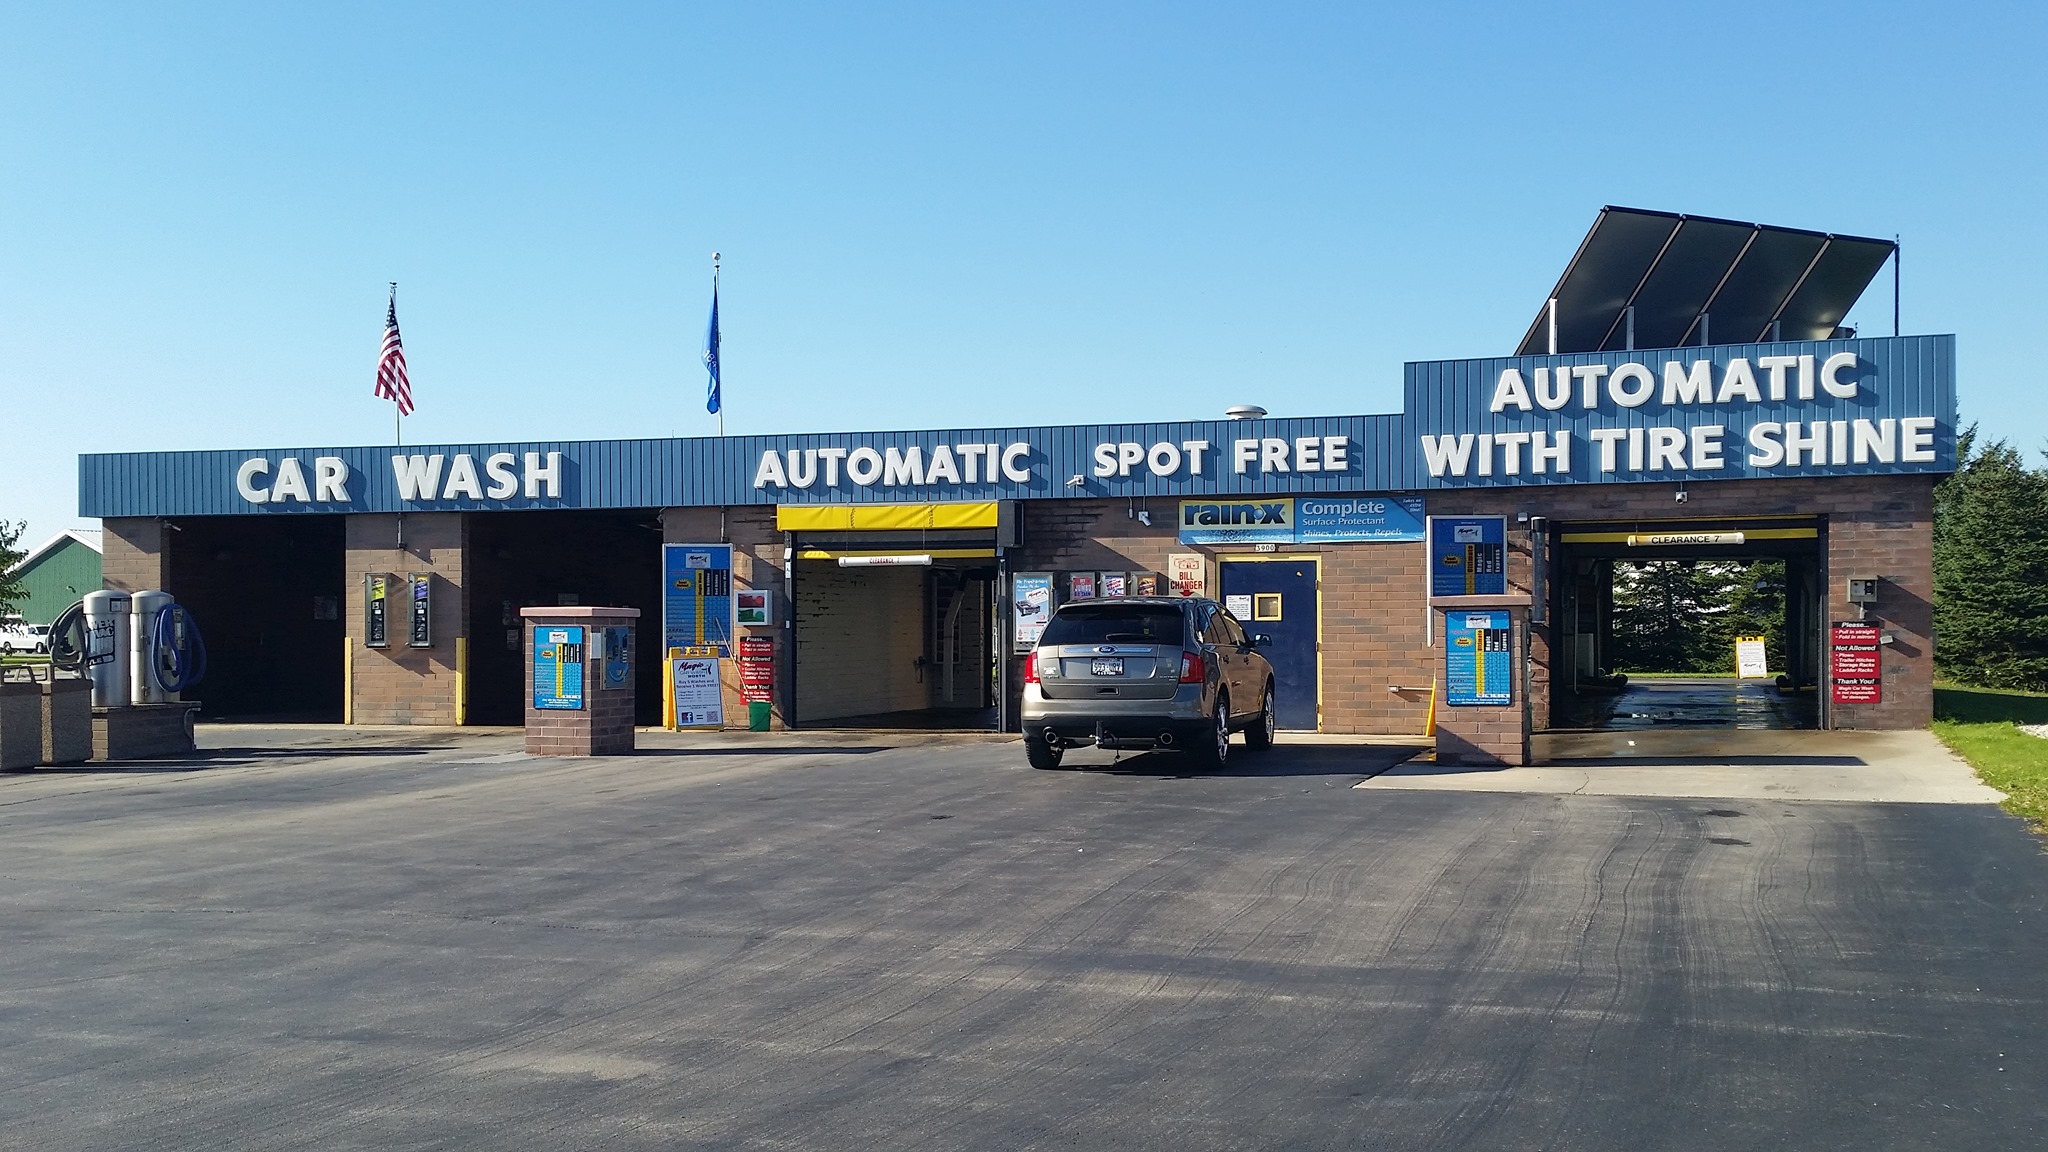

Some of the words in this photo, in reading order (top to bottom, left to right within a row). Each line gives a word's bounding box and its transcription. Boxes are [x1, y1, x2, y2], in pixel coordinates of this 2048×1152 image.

[1490, 352, 1858, 413] AUTOMATIC
[1421, 430, 1571, 478] WITH
[1590, 424, 1725, 473] TIRE
[1749, 416, 1937, 469] SHINE
[1094, 440, 1210, 478] SPOT
[1234, 435, 1349, 475] FREE
[754, 442, 1031, 489] AUTOMATIC
[236, 457, 352, 504] CAR
[392, 451, 562, 500] WASH
[1301, 500, 1385, 518] Complete
[1302, 517, 1336, 526] Surface
[1338, 516, 1385, 526] Protectant
[1302, 529, 1332, 538] Shines,
[1334, 528, 1372, 538] Protects,
[1374, 528, 1403, 538] Repels
[1651, 535, 1710, 545] CLEARANCE
[1180, 572, 1195, 581] BILL
[1170, 580, 1203, 590] CHANGER
[678, 662, 704, 672] Magic
